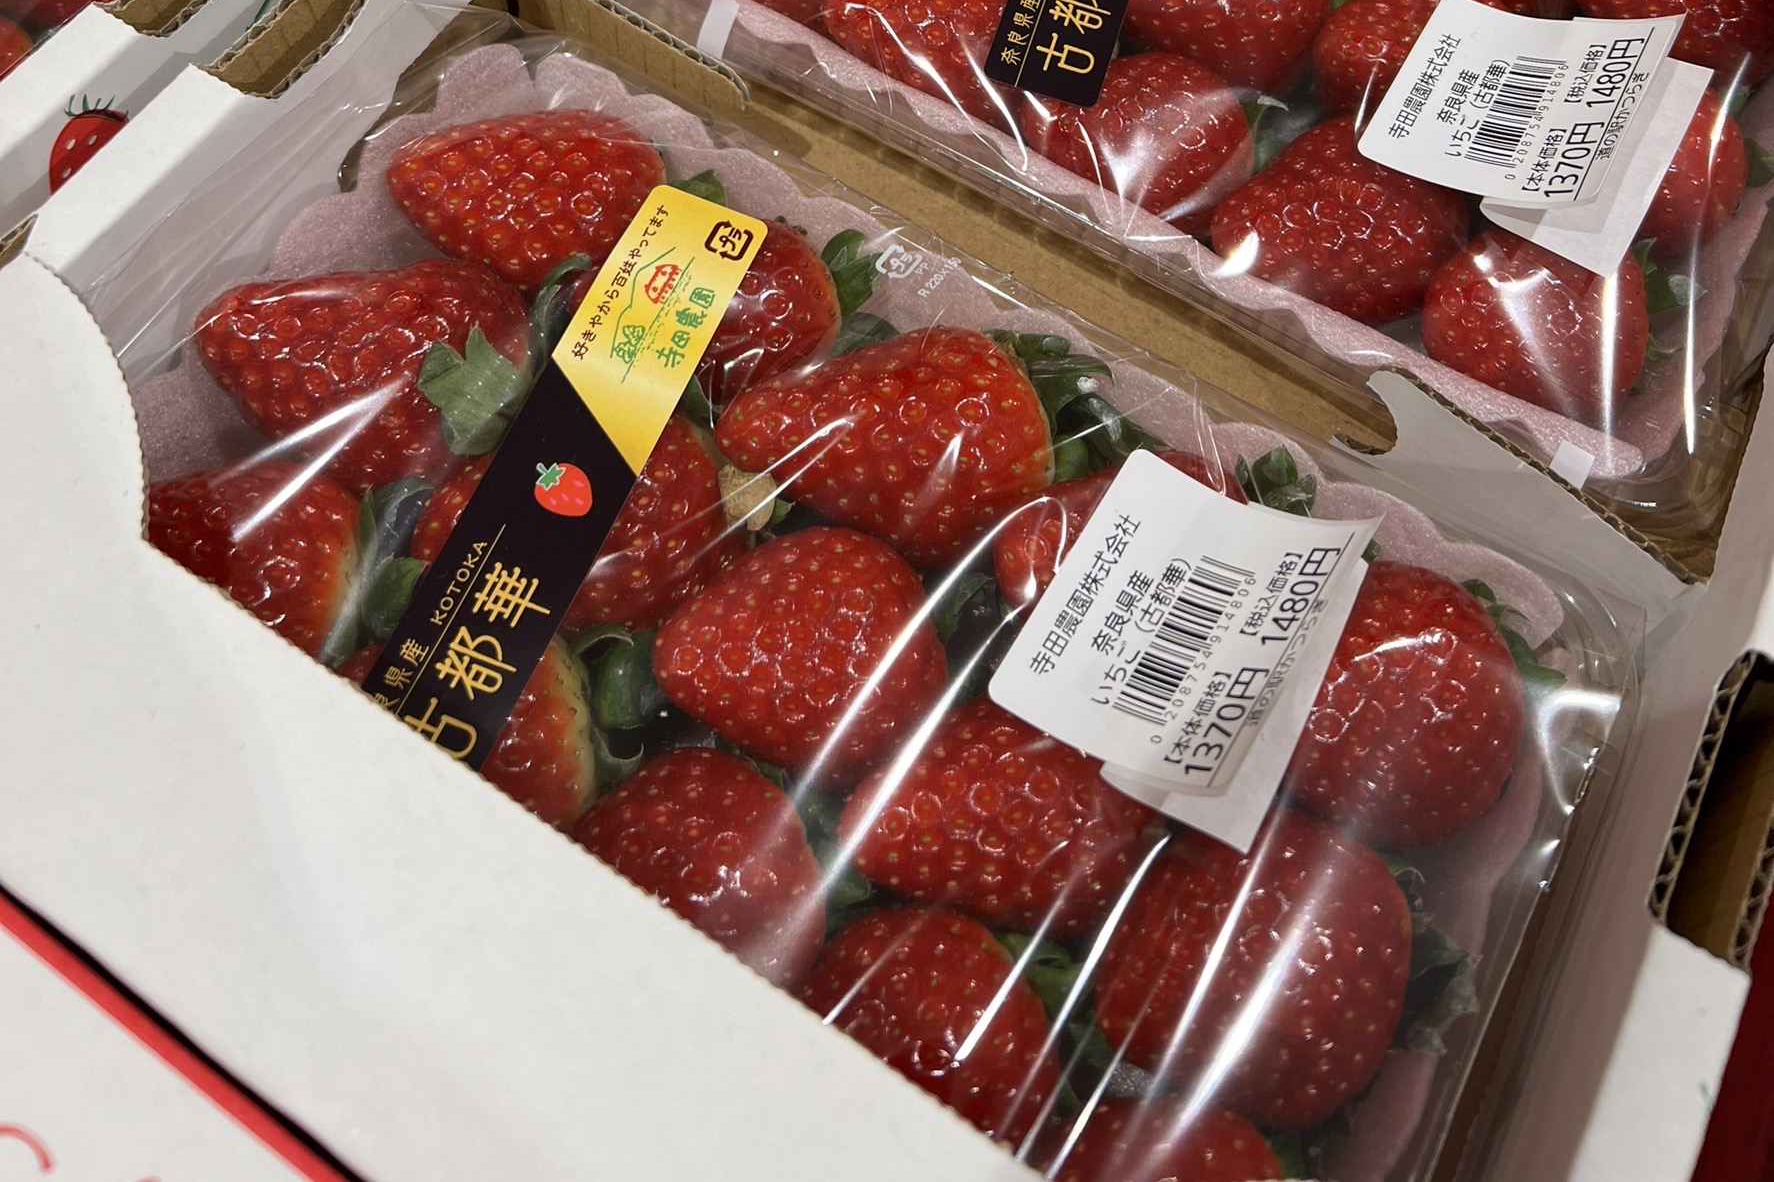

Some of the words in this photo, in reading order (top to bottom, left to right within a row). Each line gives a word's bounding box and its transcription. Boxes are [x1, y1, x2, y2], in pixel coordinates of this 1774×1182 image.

[1388, 33, 1462, 140] 寺田農園株式会社
[1436, 68, 1481, 125] 奈良県産
[1543, 121, 1606, 198] 1370円
[1585, 37, 1646, 108] 1480円
[1595, 72, 1650, 160] 道の駅かつらぎ
[571, 204, 670, 360] 好きやから百姓やってます
[914, 261, 930, 276] PP
[655, 285, 716, 369] 寺田農園
[430, 540, 488, 626] KOTOKA
[1029, 513, 1142, 676] 寺田農園株式会社
[1091, 569, 1155, 656] 奈良県産
[404, 561, 551, 759] 古都華
[1184, 666, 1270, 776] 1370円
[1260, 546, 1342, 646] 1480円
